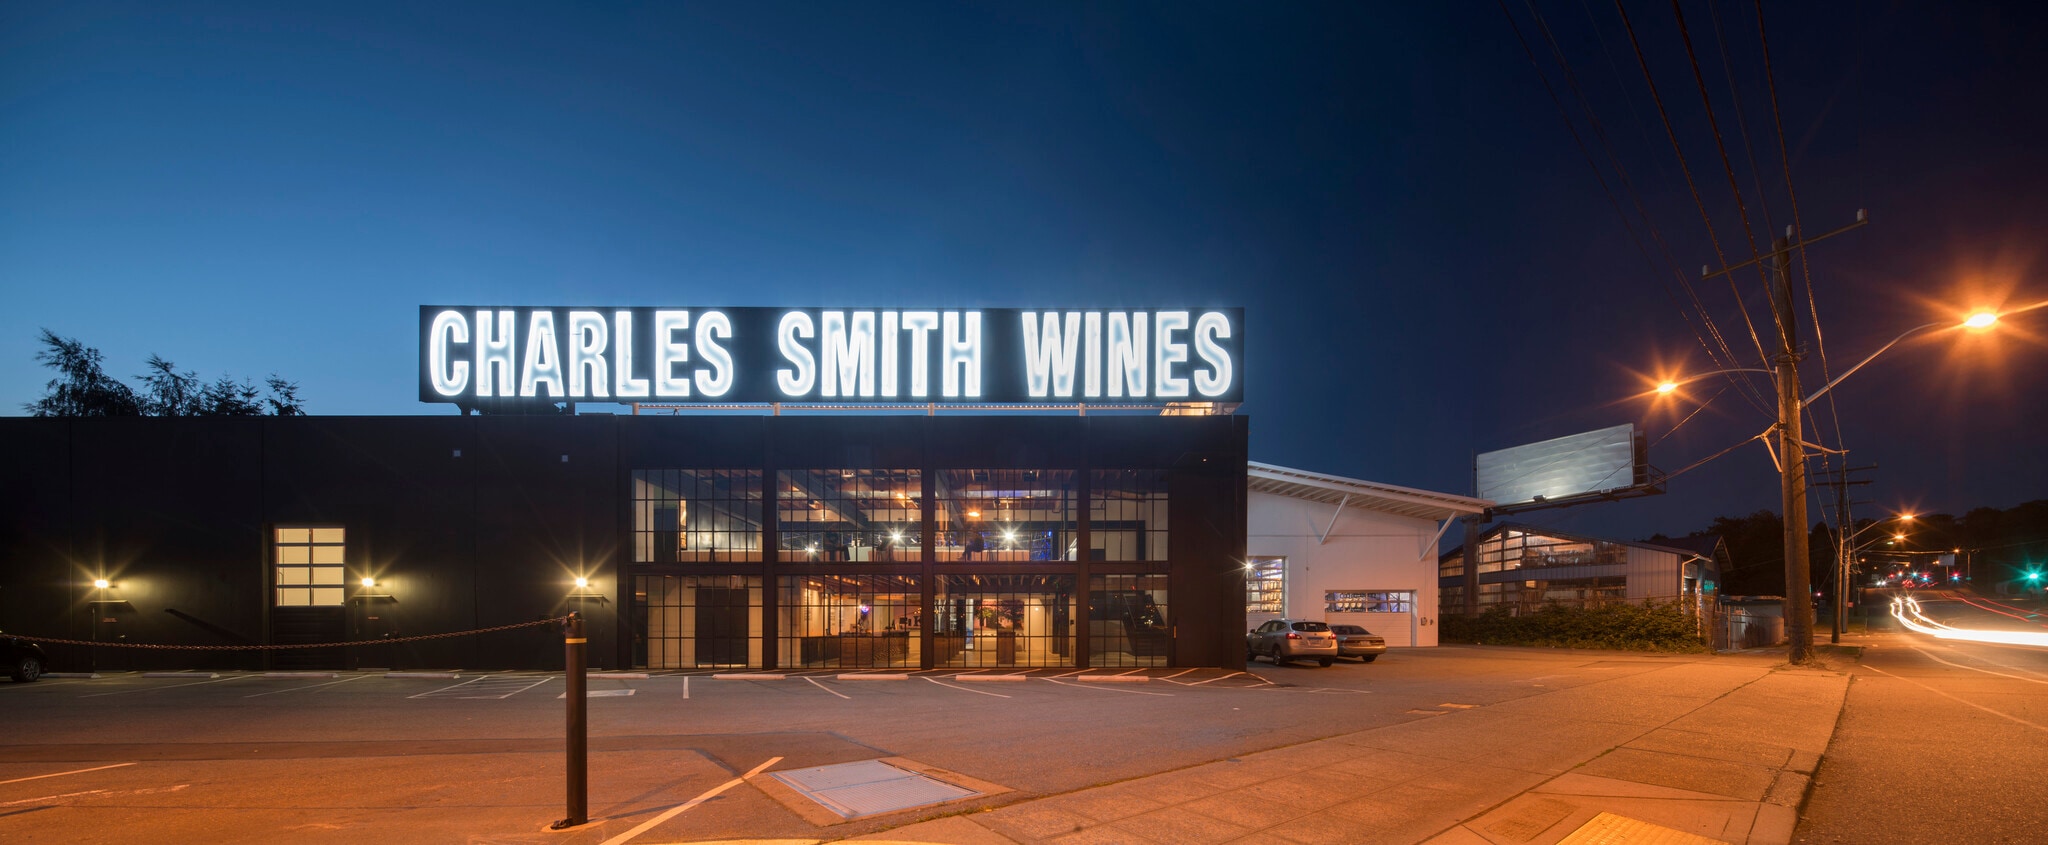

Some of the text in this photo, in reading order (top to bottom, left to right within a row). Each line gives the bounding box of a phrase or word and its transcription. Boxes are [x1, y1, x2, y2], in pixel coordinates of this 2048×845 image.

[430, 311, 1232, 397] CHARLES SMITH WINES
